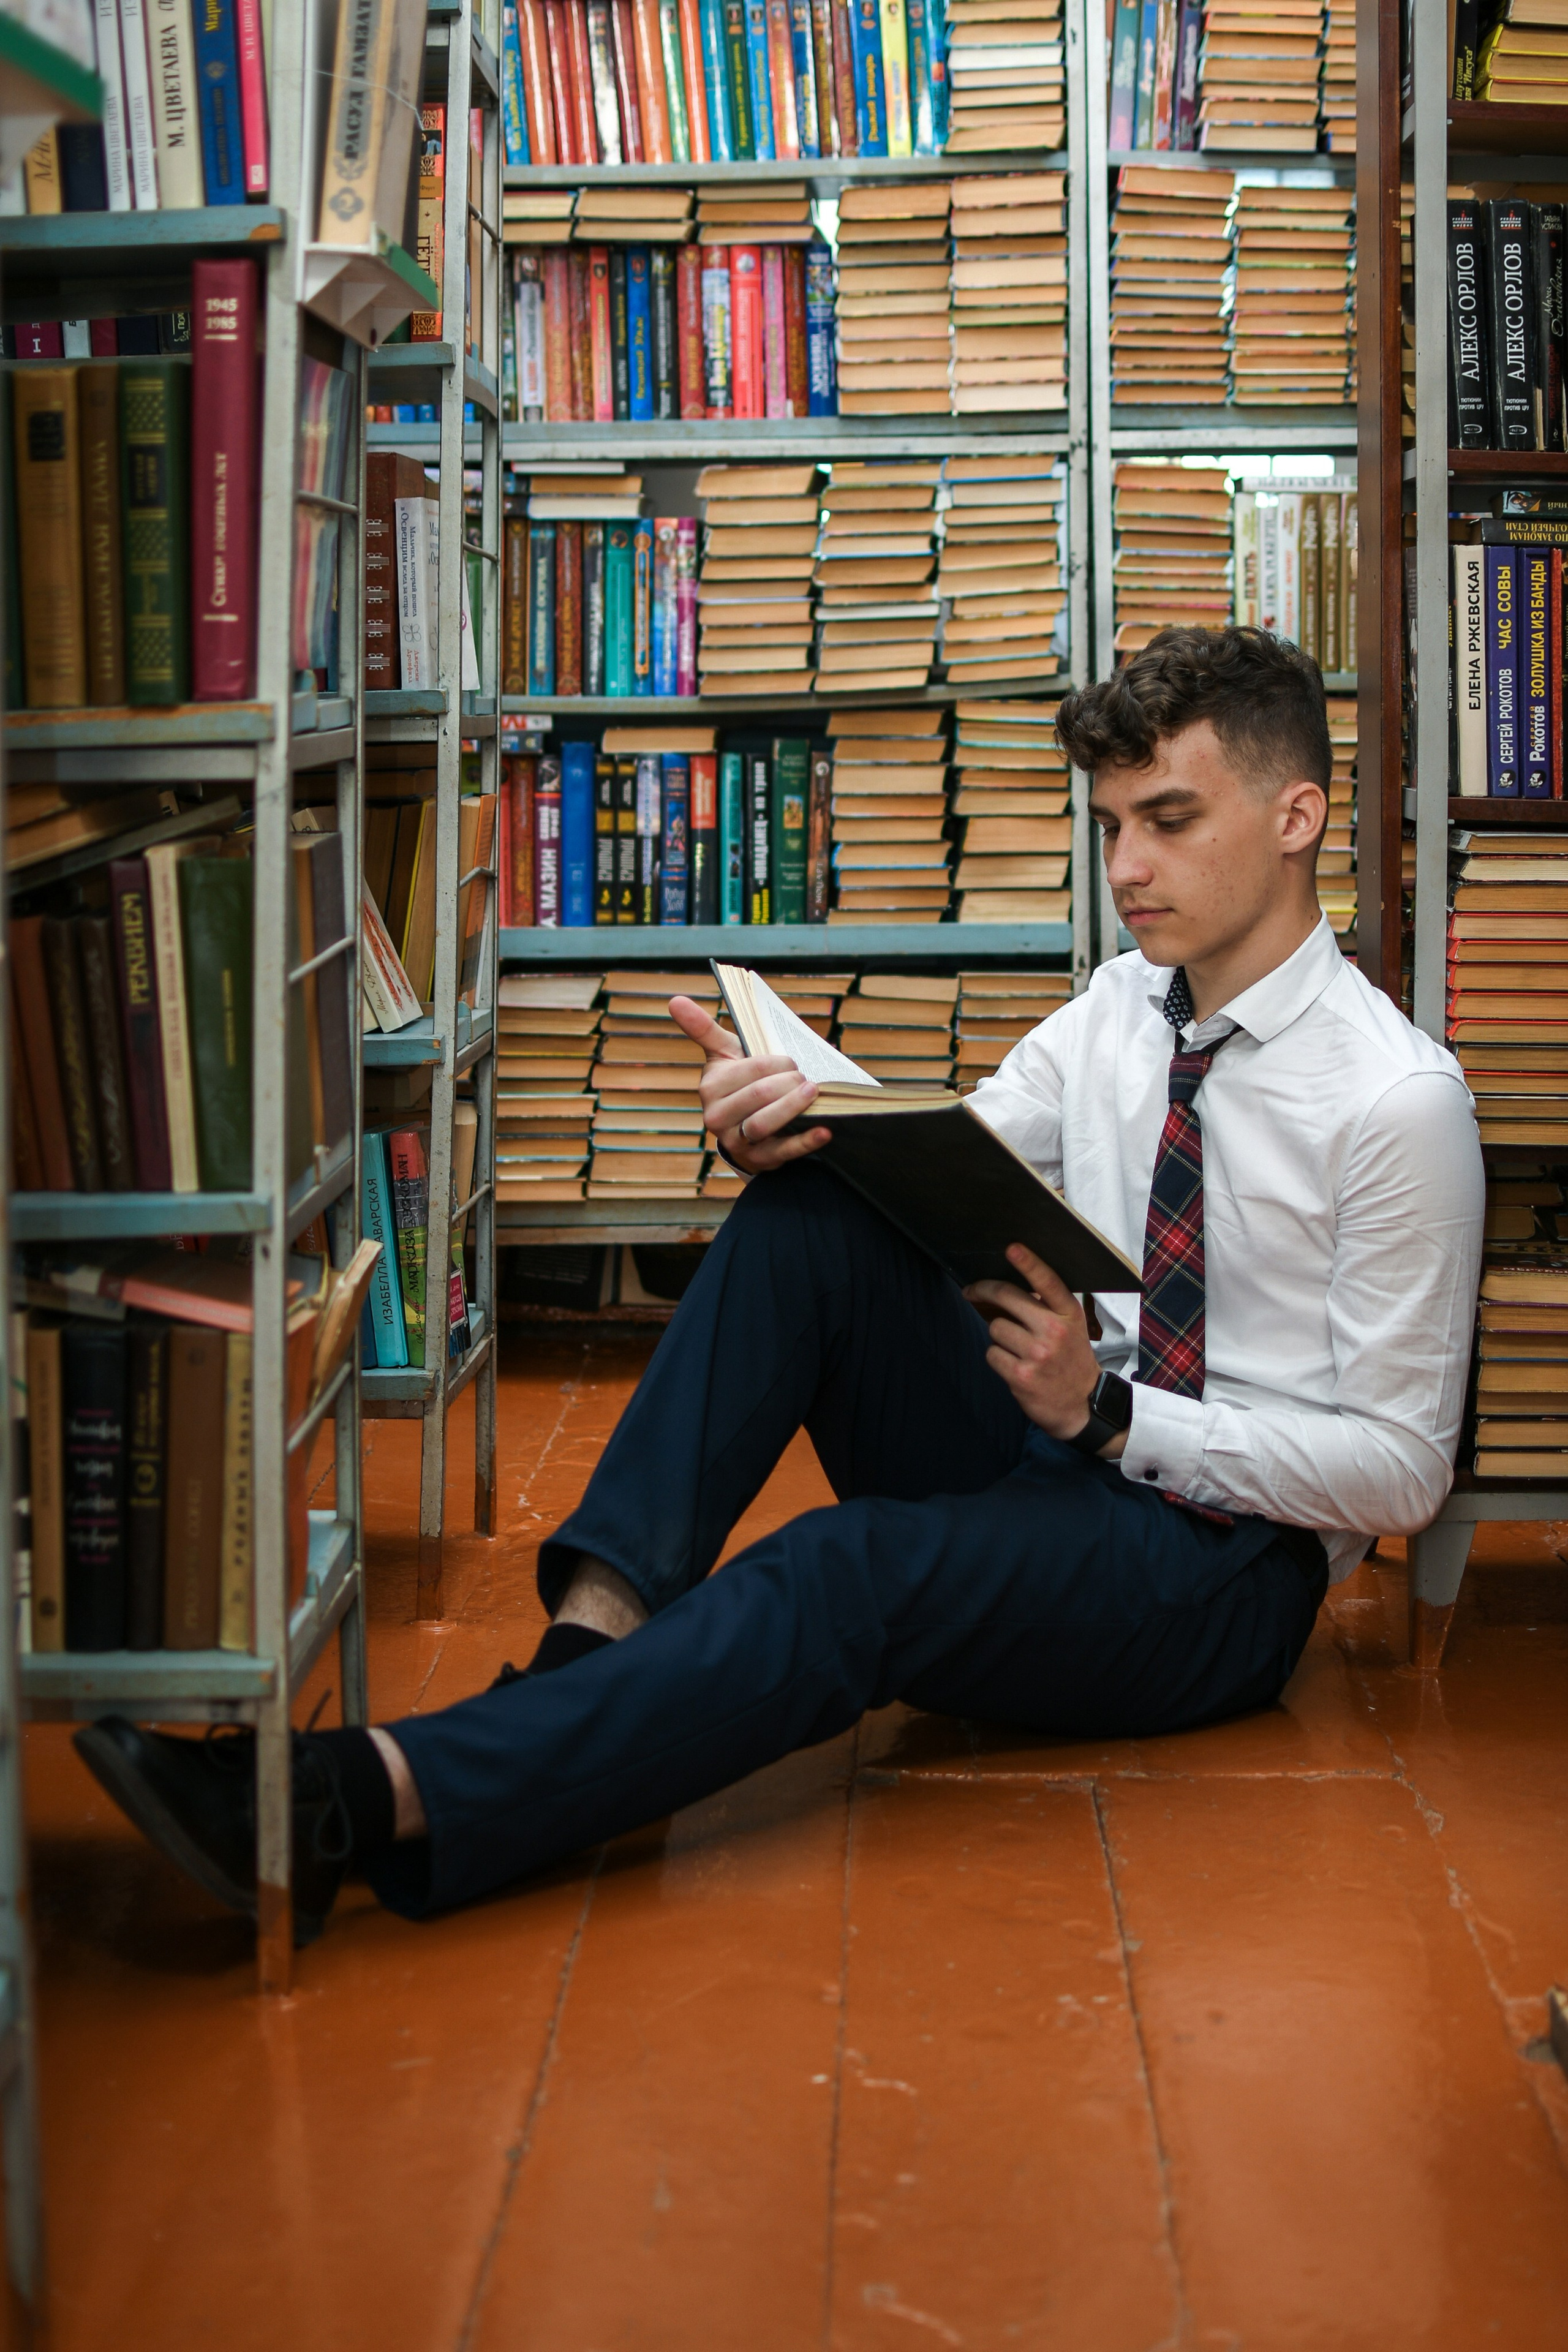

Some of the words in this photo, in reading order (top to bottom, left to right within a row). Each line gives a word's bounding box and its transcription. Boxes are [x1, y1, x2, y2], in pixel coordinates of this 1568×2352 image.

[160, 24, 186, 123] ЦВЕТАЕВА
[106, 96, 121, 148] ЦВЕТАЕВА
[134, 95, 147, 148] ЦВЕТАЕВА
[345, 91, 364, 160] РАСУЛ
[111, 149, 121, 193] МАРИНА
[138, 149, 151, 193] МАРИНА
[1456, 243, 1476, 311] ОРЛОВ
[1504, 243, 1523, 311] ОРЛОВ
[205, 298, 238, 312] 1945
[206, 316, 237, 330] 1985
[1459, 315, 1479, 382] АЛЕКС
[1506, 316, 1525, 382] АЛЕКС
[400, 512, 409, 562] Освенцим
[1506, 522, 1528, 531] СТАИ
[1510, 532, 1553, 542] ЗАКОНАМ
[1531, 522, 1568, 534] ОЛЧЬЕЙ
[1468, 561, 1480, 652] РЖЕВСКАЯ
[1498, 565, 1511, 611] СОВЫ
[1531, 560, 1547, 608] БАНДЫ
[1498, 619, 1512, 649] ЧАС
[1531, 611, 1545, 629] ИЗ
[1469, 657, 1481, 710] ЕЛЕНА
[1531, 631, 1545, 698] ЗОЛУШКА
[1499, 668, 1513, 719] РОКОТОВ
[1496, 722, 1513, 764] СЕРГЕЙ
[540, 848, 557, 910] МАЗИН
[815, 861, 823, 904] МОЦАРТ
[540, 911, 557, 929] А.
[122, 892, 151, 1006] РЕКВИЕМ
[368, 1178, 385, 1250] АВАРСКАЯ
[404, 1229, 420, 1293] МАРКИЗА
[377, 1256, 394, 1326] ИЗАБЕЛЛА
